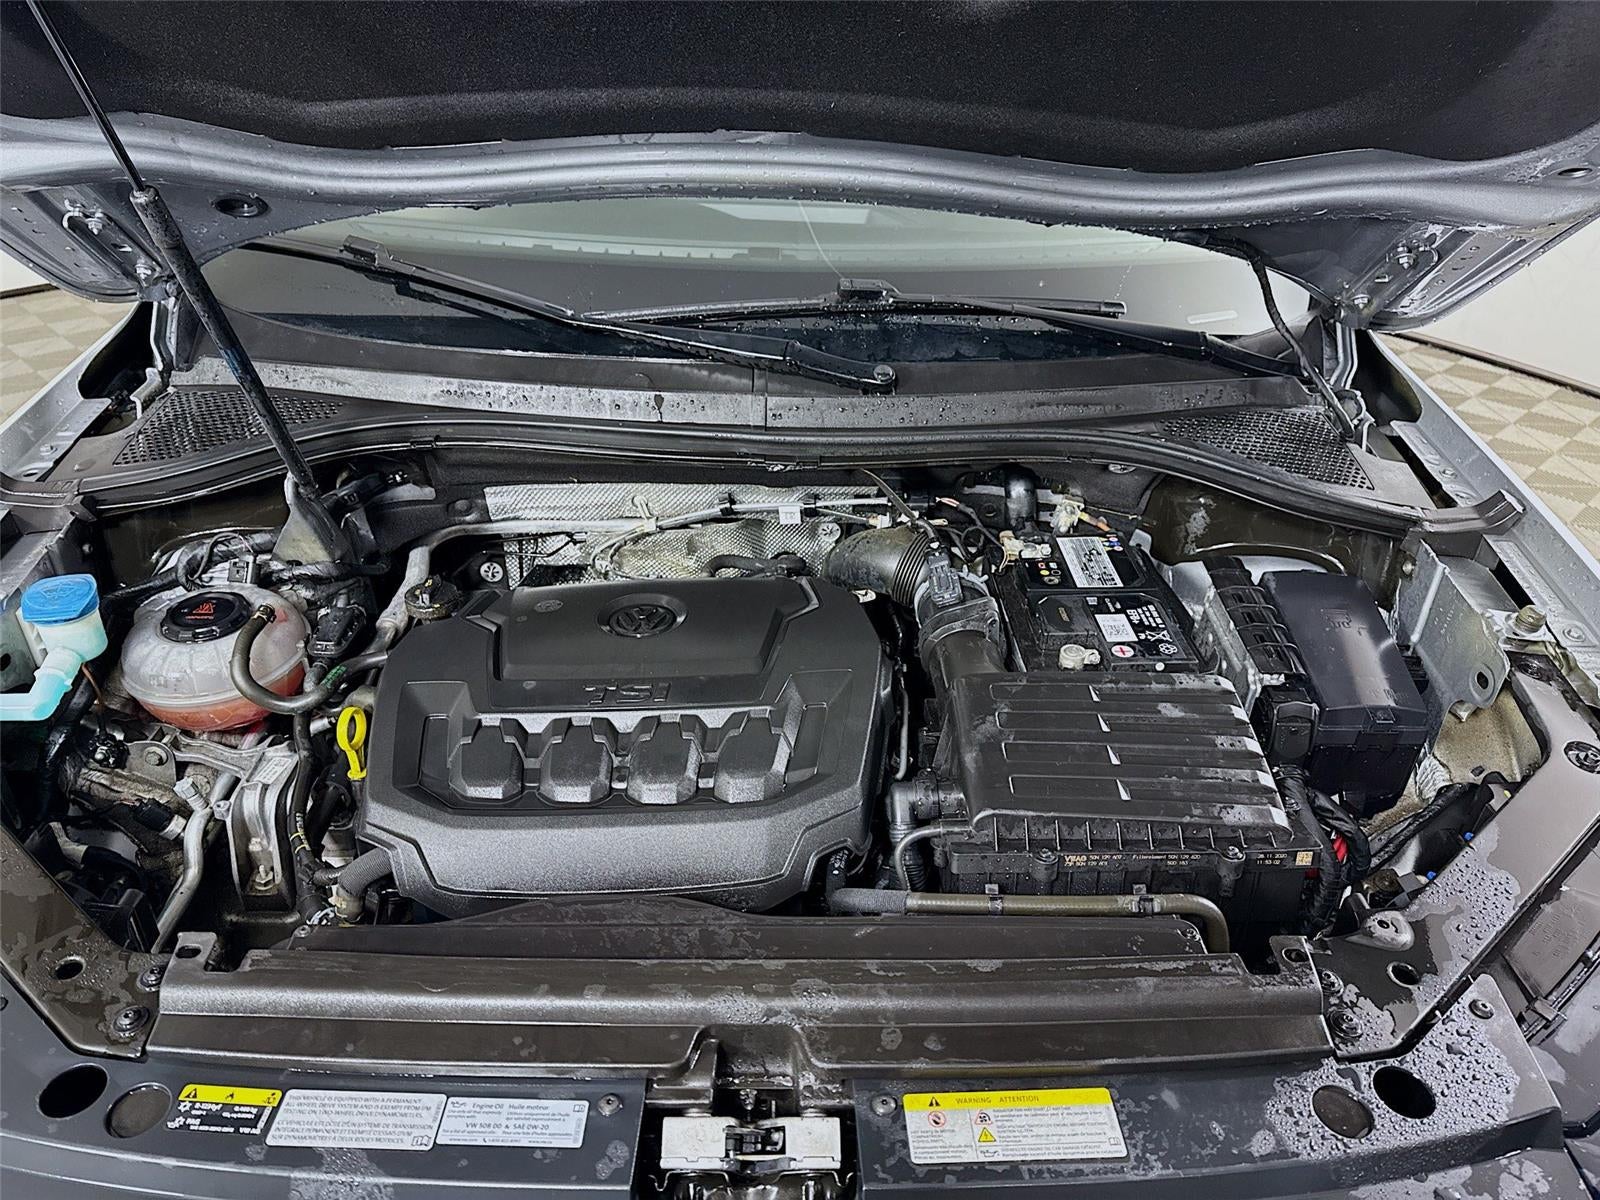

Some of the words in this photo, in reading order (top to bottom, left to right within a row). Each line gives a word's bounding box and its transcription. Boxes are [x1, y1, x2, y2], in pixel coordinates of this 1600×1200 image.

[582, 682, 671, 703] TSI
[956, 1097, 992, 1105] WARNING
[999, 1095, 1039, 1103] ATTENTION
[472, 1103, 494, 1111] Engine
